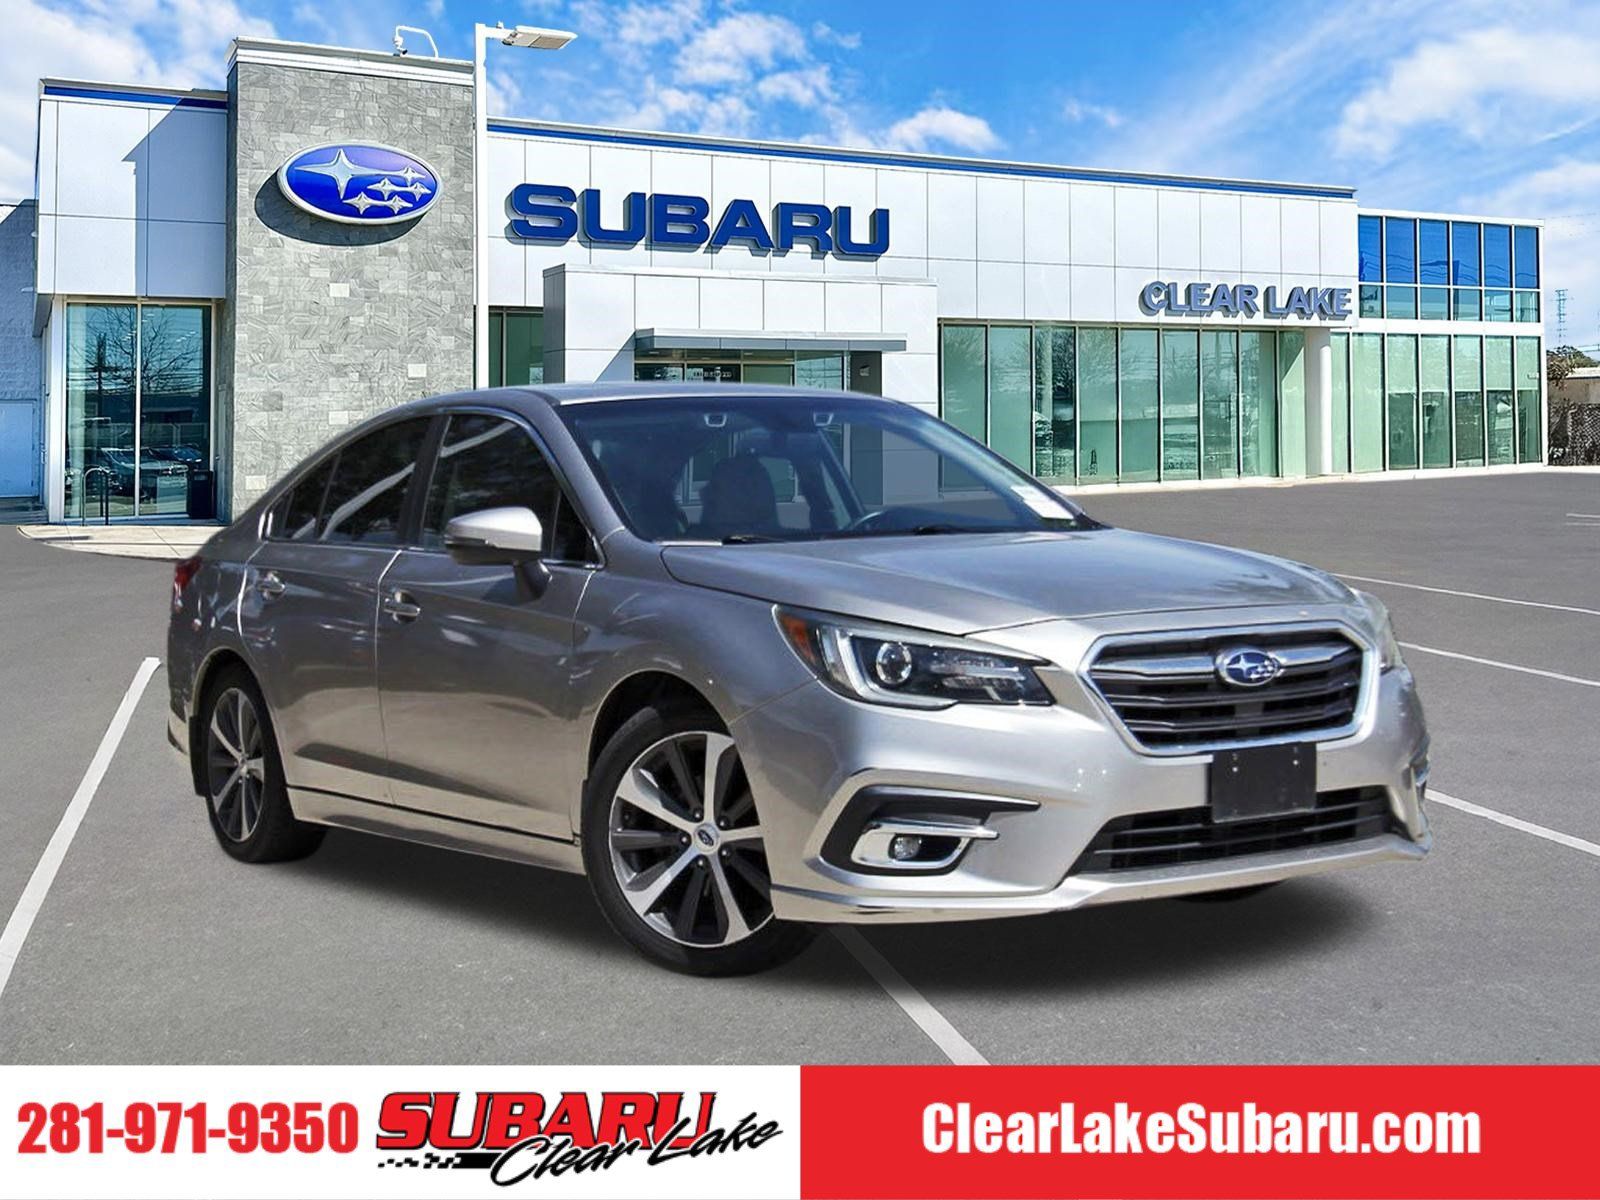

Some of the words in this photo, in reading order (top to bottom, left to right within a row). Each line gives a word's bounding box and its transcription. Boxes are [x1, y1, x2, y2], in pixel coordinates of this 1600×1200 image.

[508, 183, 890, 258] SUBARU
[1141, 281, 1260, 317] CLEAR
[1265, 286, 1353, 320] LAKE
